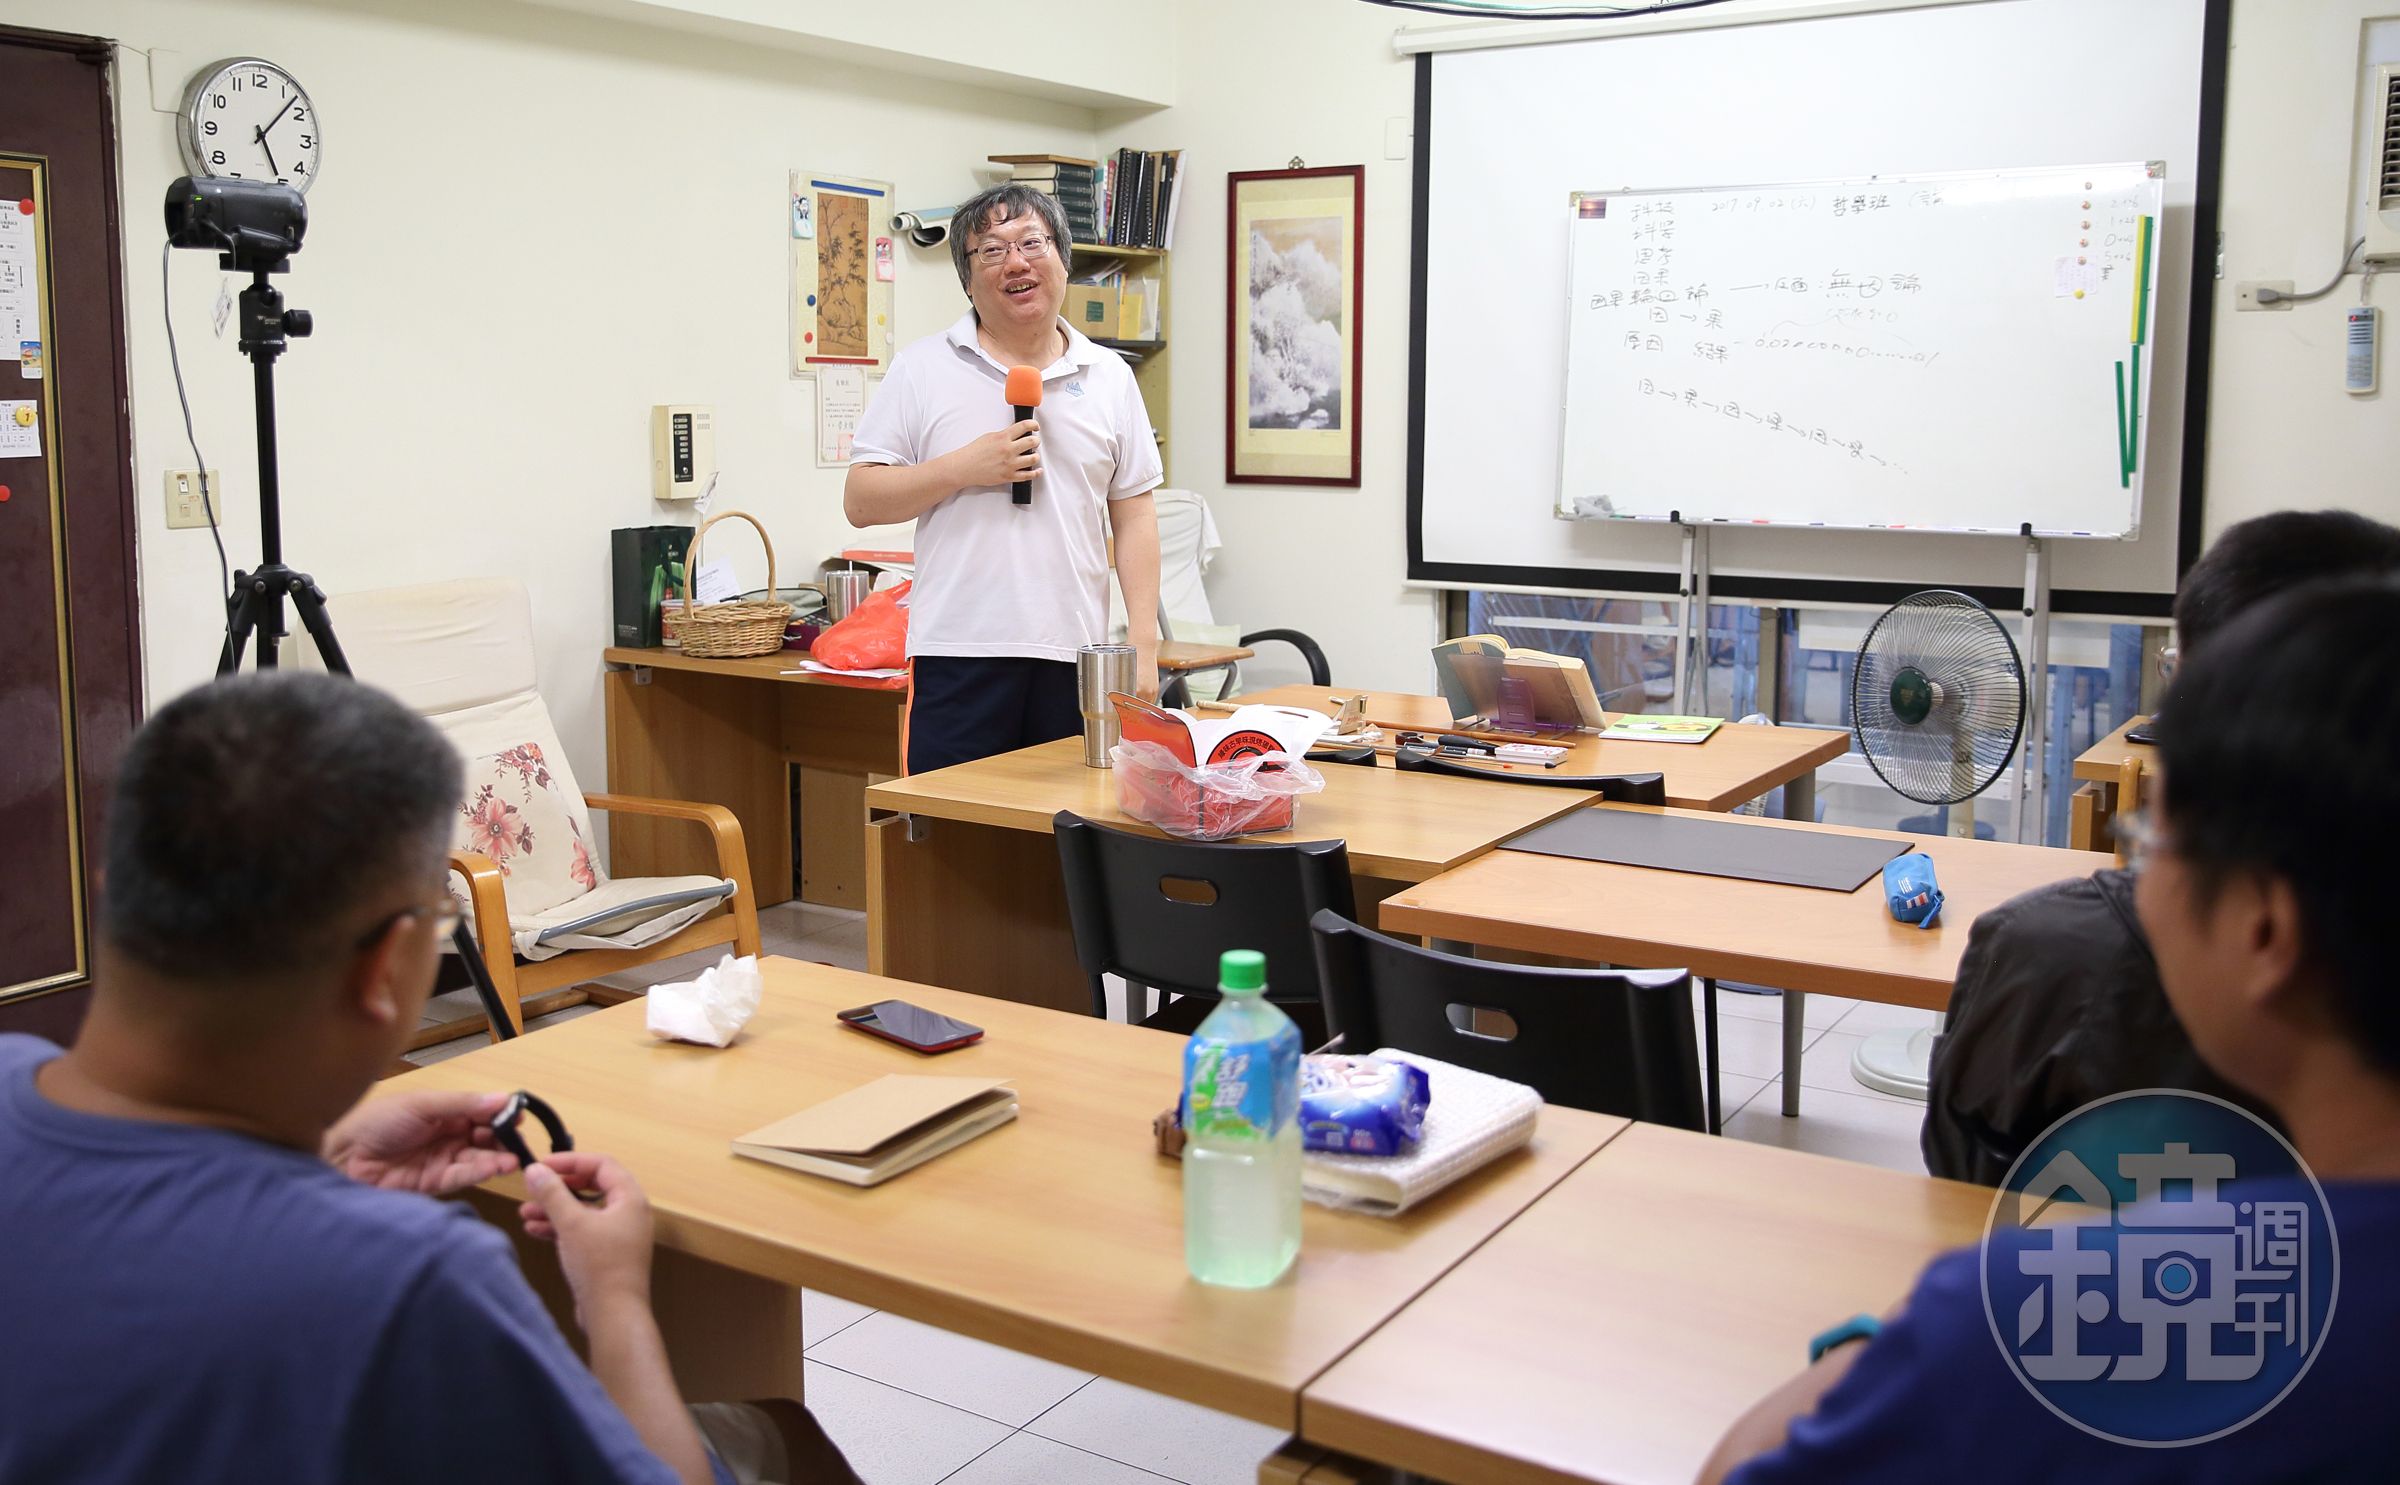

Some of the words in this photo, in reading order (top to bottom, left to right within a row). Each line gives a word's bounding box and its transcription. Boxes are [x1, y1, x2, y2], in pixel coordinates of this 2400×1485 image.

[232, 77, 242, 92] 11
[252, 73, 268, 89] 12
[281, 85, 285, 99] 1
[213, 94, 226, 109] 10
[293, 107, 305, 121] 2
[204, 121, 218, 135] 9
[300, 134, 312, 149] 3
[211, 150, 226, 165] 8
[293, 161, 305, 175] 4
